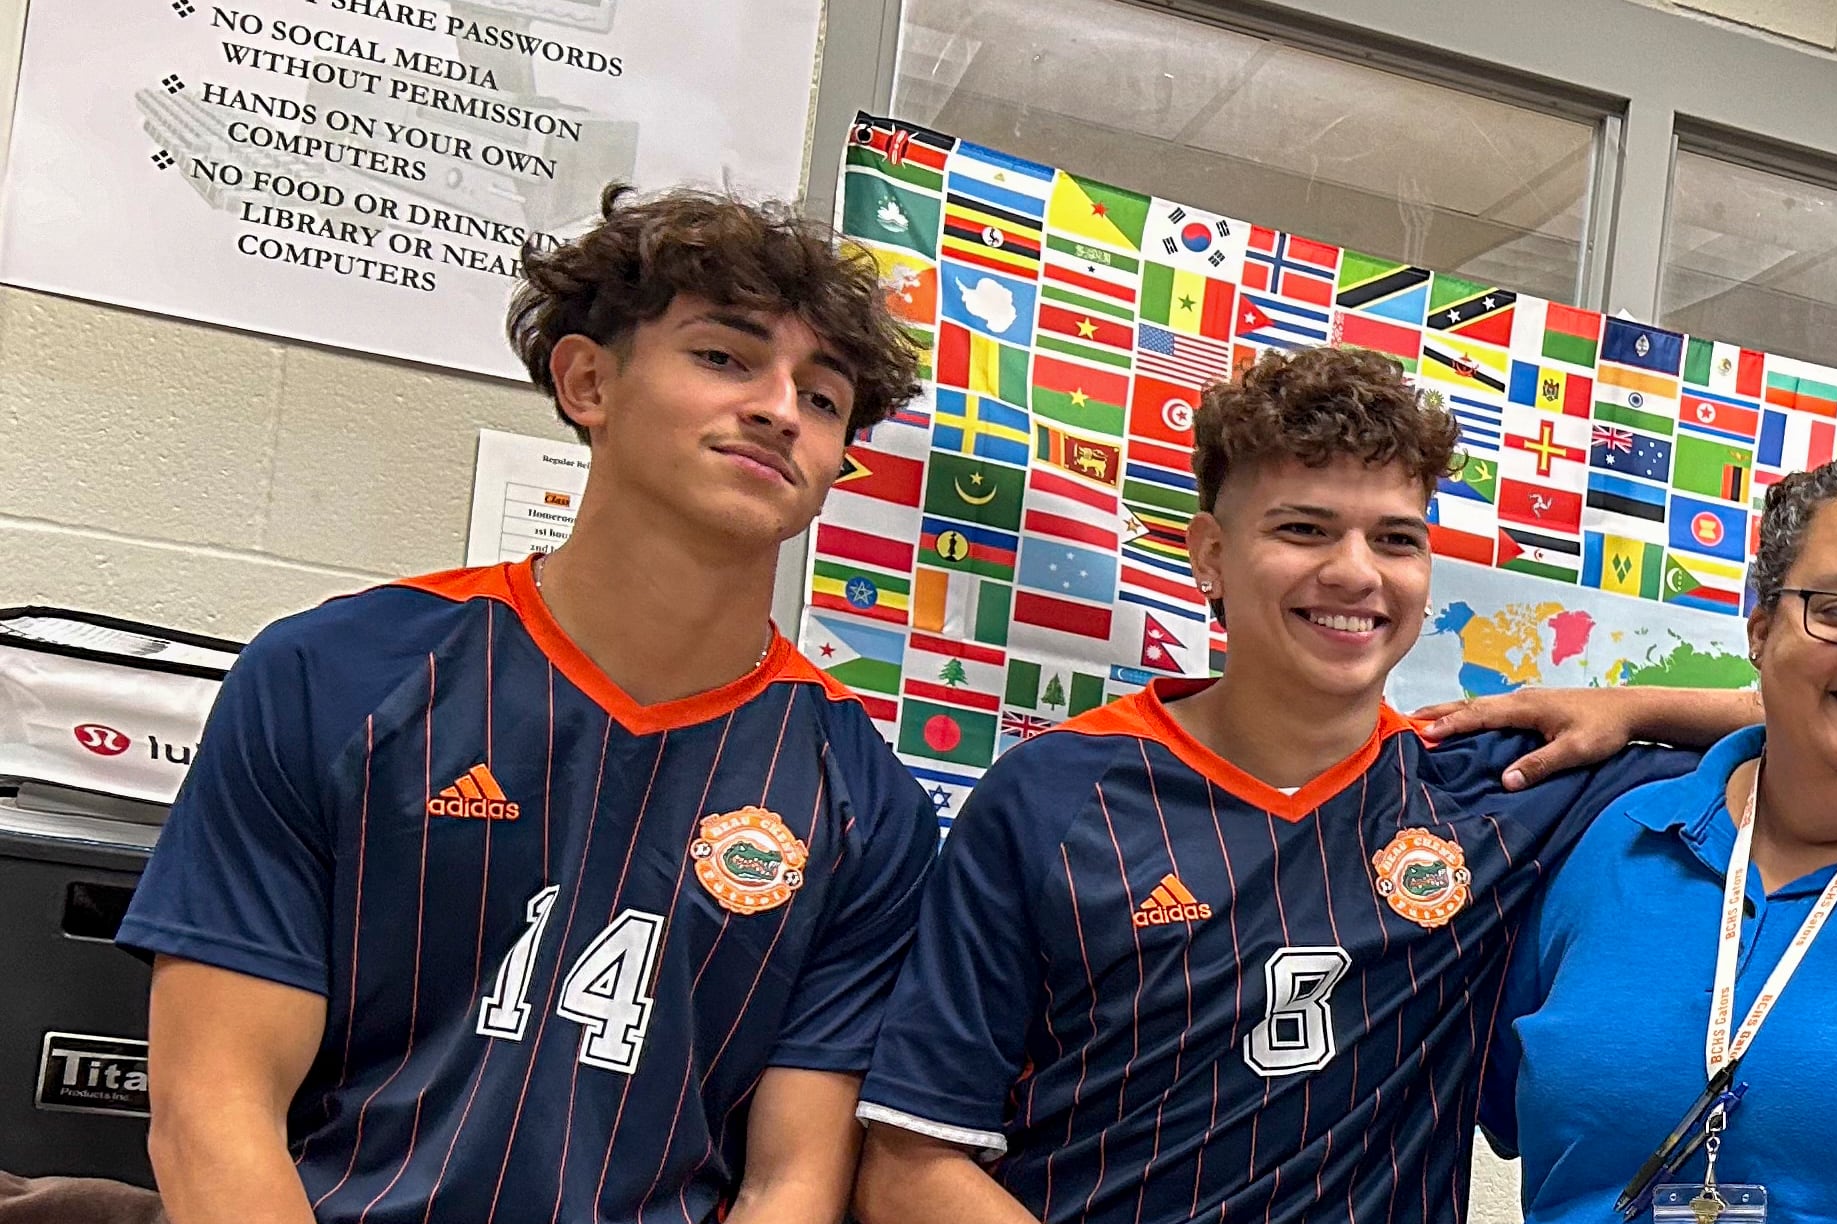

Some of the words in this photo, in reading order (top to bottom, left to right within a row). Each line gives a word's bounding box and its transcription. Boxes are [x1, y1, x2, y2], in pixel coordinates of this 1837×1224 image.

[211, 7, 263, 34] NO
[271, 20, 386, 64] SOCIAL
[393, 48, 499, 91] MEDIA
[446, 15, 623, 77] PASSWORDS
[222, 41, 382, 95] WITHOUT
[388, 78, 583, 143] PERMISSION
[201, 82, 317, 125] HANDS
[326, 110, 377, 139] ON
[384, 121, 473, 161] YOUR
[481, 145, 558, 180] OWN
[228, 121, 427, 182] COMPUTERS
[190, 158, 243, 186] NO
[252, 170, 345, 207] FOOD
[354, 193, 399, 221] OR
[406, 203, 525, 247] DRINKS
[239, 201, 382, 248] LIBRARY
[388, 233, 433, 261] OR
[440, 243, 523, 279] NEAR
[238, 234, 437, 292] COMPUTERS
[542, 454, 575, 468] Regular
[528, 508, 576, 524] Homeroo
[544, 494, 570, 506] Class
[549, 528, 571, 540] hou
[148, 735, 200, 765] lu
[427, 797, 520, 820] adidas
[711, 815, 751, 836] BEAU
[1382, 841, 1408, 871] BEAU
[1728, 867, 1744, 906] Gators
[1132, 902, 1214, 928] adidas
[1725, 907, 1738, 940] BCHS
[475, 884, 666, 1075] 14
[1242, 945, 1353, 1077] 8
[1714, 986, 1730, 1025] Gators
[1746, 993, 1774, 1027] BCHS
[1711, 1028, 1726, 1065] BCHS
[51, 1048, 149, 1092] Tita
[59, 1087, 112, 1100] Products
